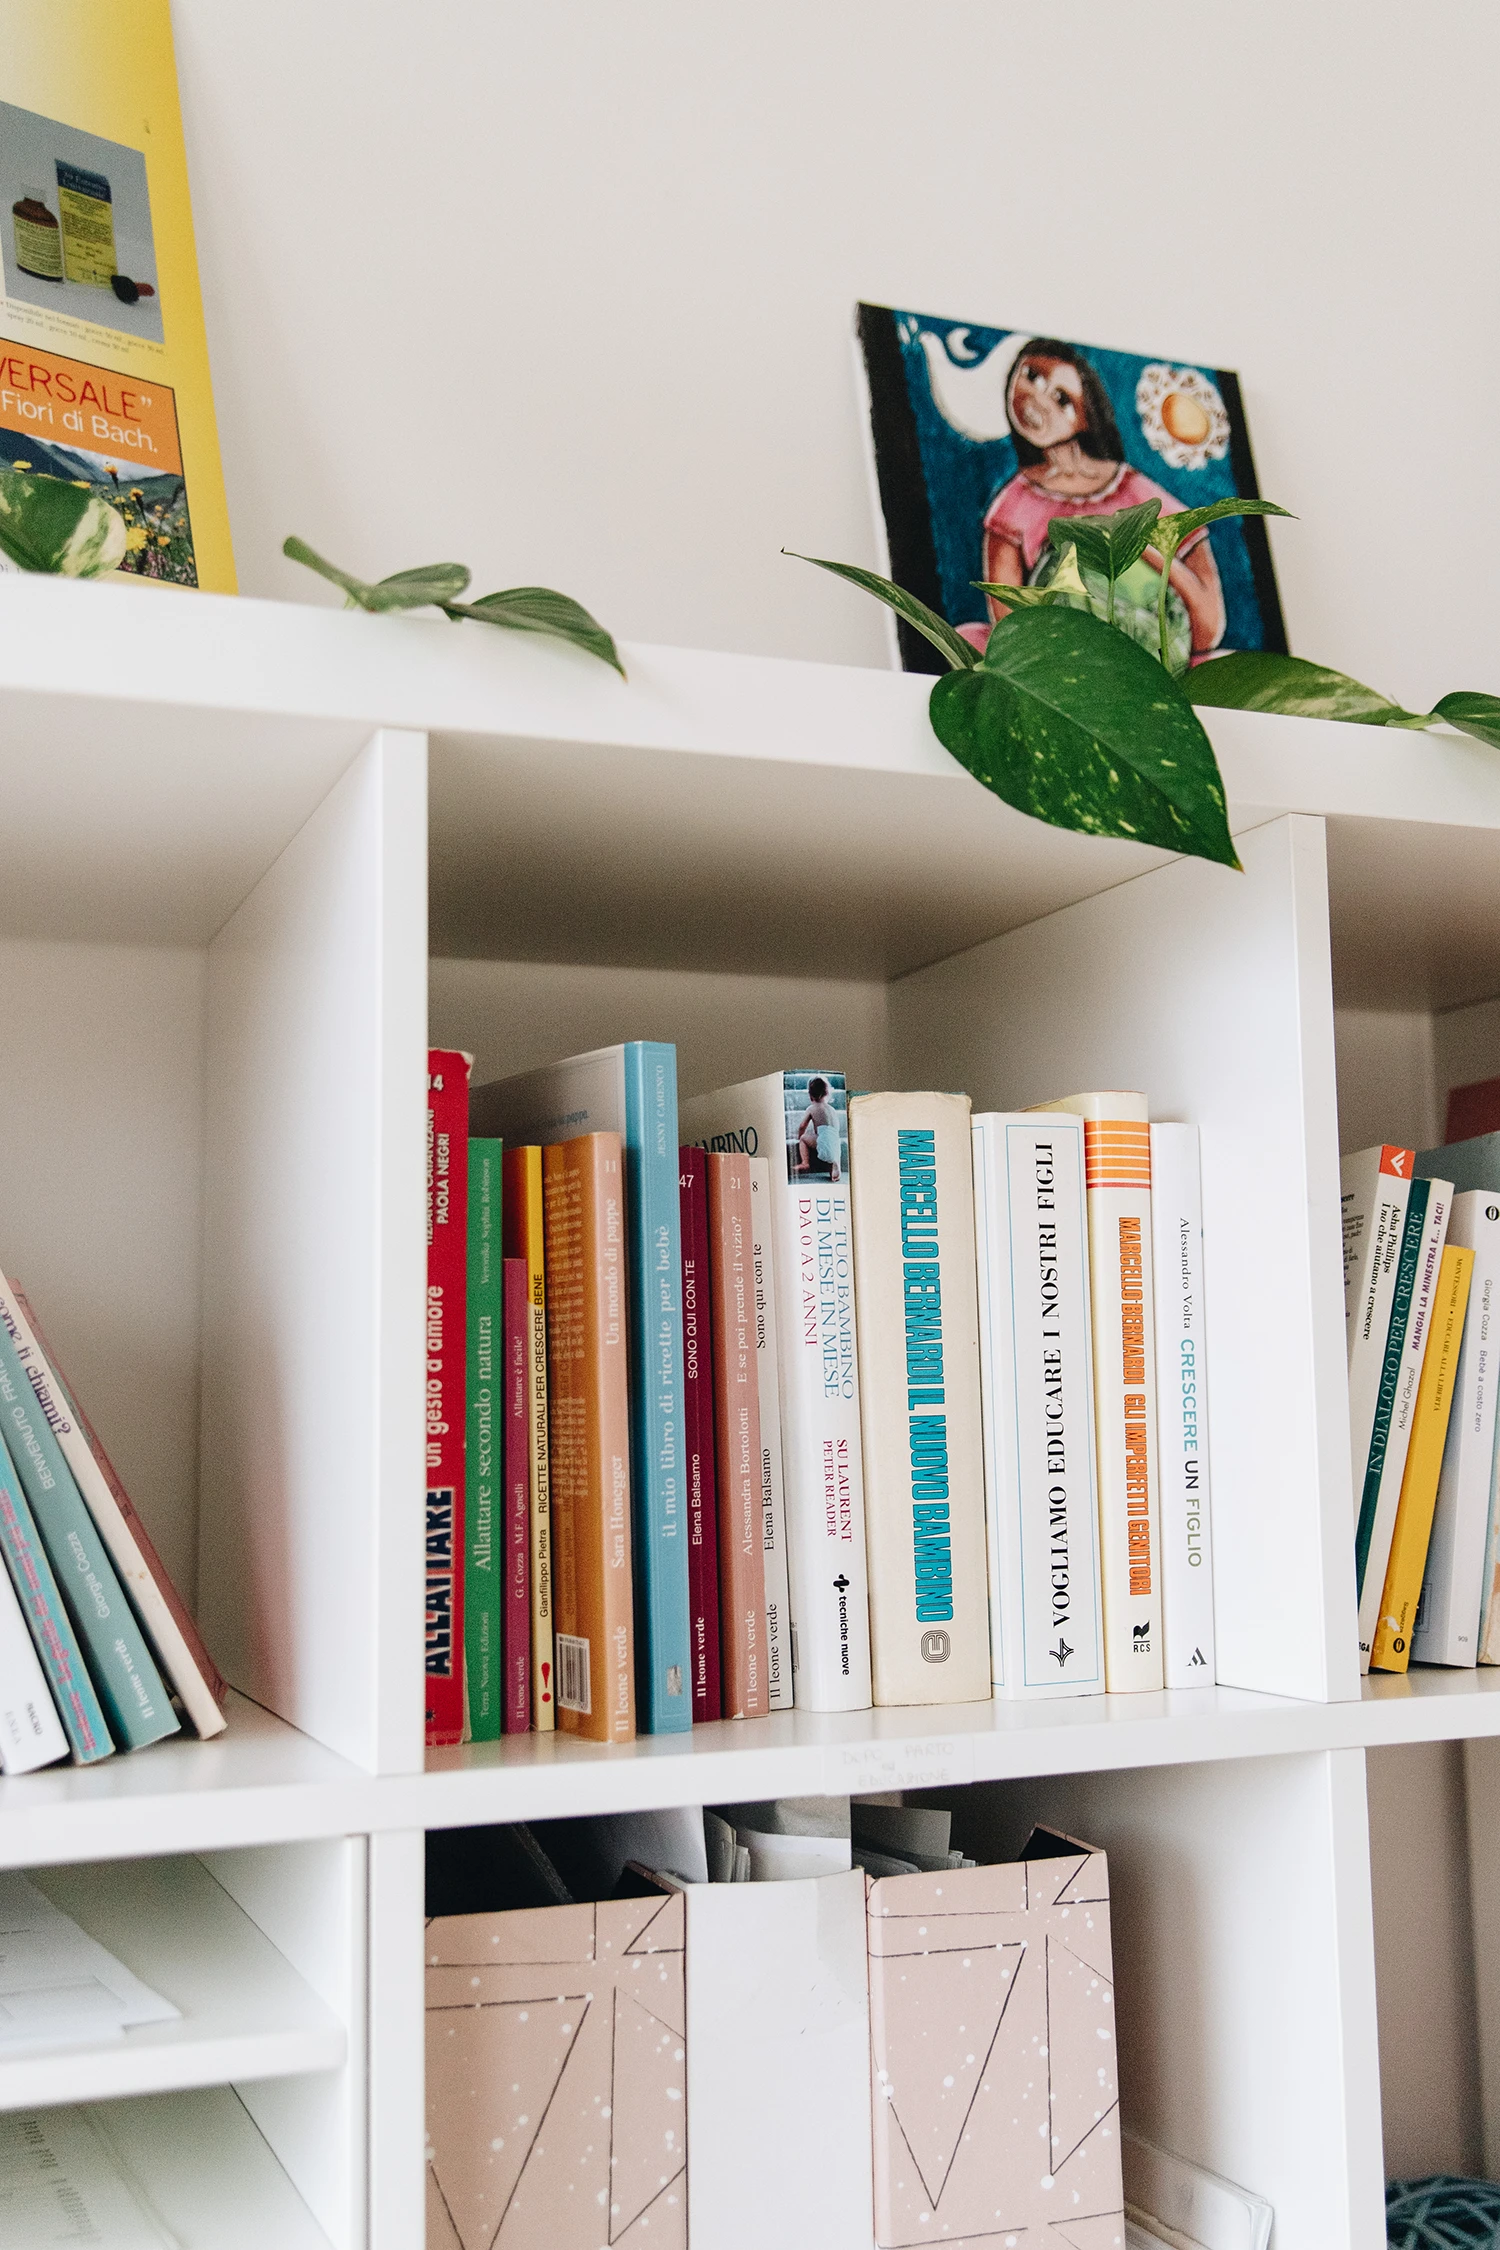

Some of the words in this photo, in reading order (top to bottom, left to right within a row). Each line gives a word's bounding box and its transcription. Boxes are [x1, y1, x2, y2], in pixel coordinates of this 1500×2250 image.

[2, 389, 53, 425] Fiori
[63, 410, 84, 433] di
[91, 415, 158, 454] Bach.
[437, 1133, 450, 1177] NEGRI
[679, 1173, 695, 1189] 47
[730, 1177, 741, 1190] 21
[751, 1180, 759, 1192] 8
[897, 1129, 940, 1259] MARCELLO
[1034, 1141, 1056, 1211] FIGLI
[437, 1179, 449, 1225] PAOLA
[603, 1198, 621, 1243] pappe
[798, 1198, 812, 1227] DA
[816, 1198, 831, 1224] DI
[833, 1198, 846, 1220] IL
[1379, 1209, 1388, 1222] no
[1389, 1204, 1403, 1231] Asha
[1433, 1202, 1445, 1225] TACI!
[654, 1225, 670, 1272] bebè
[731, 1216, 743, 1259] vizio?
[752, 1243, 762, 1256] te
[834, 1225, 848, 1278] TUO
[1376, 1224, 1388, 1243] che
[603, 1247, 618, 1262] di
[684, 1259, 696, 1277] TE
[732, 1263, 744, 1272] il
[754, 1260, 763, 1285] con
[800, 1251, 814, 1266] A
[817, 1230, 834, 1294] MESE
[1038, 1222, 1060, 1319] NOSTRI
[1118, 1216, 1144, 1301] MARCELLO
[1180, 1217, 1193, 1290] Alessandro
[1370, 1244, 1386, 1285] aiutano
[1381, 1233, 1398, 1274] Phillips
[1395, 1212, 1425, 1312] CRESCERE
[1421, 1247, 1438, 1294] MINESTRA
[533, 1273, 543, 1305] BENE
[604, 1266, 619, 1318] mondo
[657, 1278, 676, 1313] per
[685, 1279, 697, 1310] CON
[801, 1271, 815, 1282] 2
[1449, 1257, 1464, 1308] MONTESSORI
[1482, 1278, 1493, 1311] Giorgia
[733, 1276, 748, 1323] prende
[755, 1289, 767, 1311] qui
[802, 1289, 818, 1347] ANNI
[820, 1301, 836, 1327] IN
[1182, 1294, 1194, 1329] Volta
[1362, 1296, 1376, 1341] crescere
[1418, 1296, 1428, 1307] LA
[426, 1285, 444, 1372] d'amore
[534, 1309, 545, 1373] CRESCERE
[605, 1322, 620, 1345] Un
[685, 1312, 697, 1337] QUI
[735, 1327, 749, 1350] poi
[756, 1314, 766, 1349] Sono
[837, 1285, 855, 1400] BAMBINO
[902, 1262, 945, 1386] BERNARDI
[1042, 1329, 1060, 1339] I
[1387, 1316, 1407, 1353] PER
[1411, 1311, 1426, 1351] MANGIA
[1442, 1317, 1455, 1355] EDUCARE
[1481, 1314, 1491, 1341] Cozza
[17, 1346, 35, 1361] ti
[474, 1315, 492, 1379] natura
[512, 1336, 523, 1366] facile!
[656, 1320, 674, 1386] ricette
[686, 1339, 698, 1379] SONO
[738, 1354, 747, 1369] se
[1120, 1302, 1146, 1385] BERNARDI
[1479, 1349, 1489, 1374] Bebè
[737, 1372, 748, 1383] E
[822, 1333, 840, 1399] MESE
[1402, 1366, 1417, 1400] Ghazal
[25, 1365, 72, 1435] chiami?
[513, 1377, 523, 1418] Allattare
[535, 1373, 546, 1400] PER
[658, 1391, 674, 1414] di
[907, 1388, 947, 1411] IL
[1180, 1339, 1199, 1452] CRESCERE
[1372, 1356, 1400, 1449] DIALOGO
[1475, 1385, 1485, 1410] costo
[427, 1379, 450, 1435] gesto
[1042, 1349, 1067, 1475] EDUCARE
[1123, 1393, 1147, 1420] GLI
[1398, 1400, 1412, 1431] Michel
[1474, 1412, 1483, 1433] zero
[12, 1406, 57, 1490] BENVENUTO
[473, 1388, 492, 1477] secondo
[536, 1403, 547, 1461] NATURALI
[659, 1421, 676, 1470] libro
[738, 1407, 751, 1475] Bortolotti
[836, 1439, 848, 1459] SU
[427, 1443, 442, 1467] un
[822, 1440, 835, 1481] PETER
[908, 1414, 950, 1501] NUOVO
[1124, 1422, 1150, 1517] IMPERFETTI
[1184, 1459, 1199, 1489] UN
[1368, 1451, 1384, 1476] IN
[538, 1464, 548, 1514] RICETTE
[610, 1455, 627, 1530] Honegger
[660, 1477, 677, 1515] mio
[690, 1453, 702, 1508] Balsamo
[761, 1448, 773, 1507] Balsamo
[513, 1483, 526, 1518] Agnelli
[741, 1478, 754, 1556] Alessandra
[824, 1484, 837, 1537] READER
[837, 1464, 853, 1543] LAURENT
[474, 1485, 492, 1571] Allattare
[514, 1521, 524, 1545] M.F.
[538, 1529, 548, 1559] Pietra
[661, 1521, 677, 1538] il
[691, 1511, 703, 1545] Elena
[763, 1512, 775, 1550] Elena
[1185, 1498, 1202, 1567] FIGLIO
[66, 1531, 91, 1573] Cozza
[515, 1552, 524, 1584] Cozza
[610, 1535, 626, 1569] Sara
[911, 1501, 955, 1624] BAMBINO
[1047, 1485, 1071, 1628] VOGLIAMO
[1126, 1519, 1152, 1596] GENITORI
[86, 1572, 112, 1620] Giorgia
[515, 1585, 525, 1599] G.
[538, 1562, 550, 1618] Gianfilippo
[480, 1612, 491, 1653] Edizioni
[694, 1616, 706, 1651] verde
[744, 1610, 757, 1650] verde
[766, 1603, 779, 1641] verde
[837, 1595, 849, 1641] tecniche
[112, 1638, 135, 1673] verde
[612, 1626, 628, 1670] verde
[769, 1646, 781, 1684] leone
[840, 1643, 850, 1676] nuove
[1133, 1643, 1152, 1653] RCS
[516, 1656, 526, 1682] verde
[696, 1653, 706, 1685] leone
[746, 1654, 759, 1692] leone
[129, 1673, 150, 1707] leone
[480, 1692, 490, 1717] Terra
[516, 1684, 526, 1709] leone
[614, 1673, 629, 1716] leone
[748, 1697, 758, 1708] Il
[904, 1741, 956, 1760] PARTO
